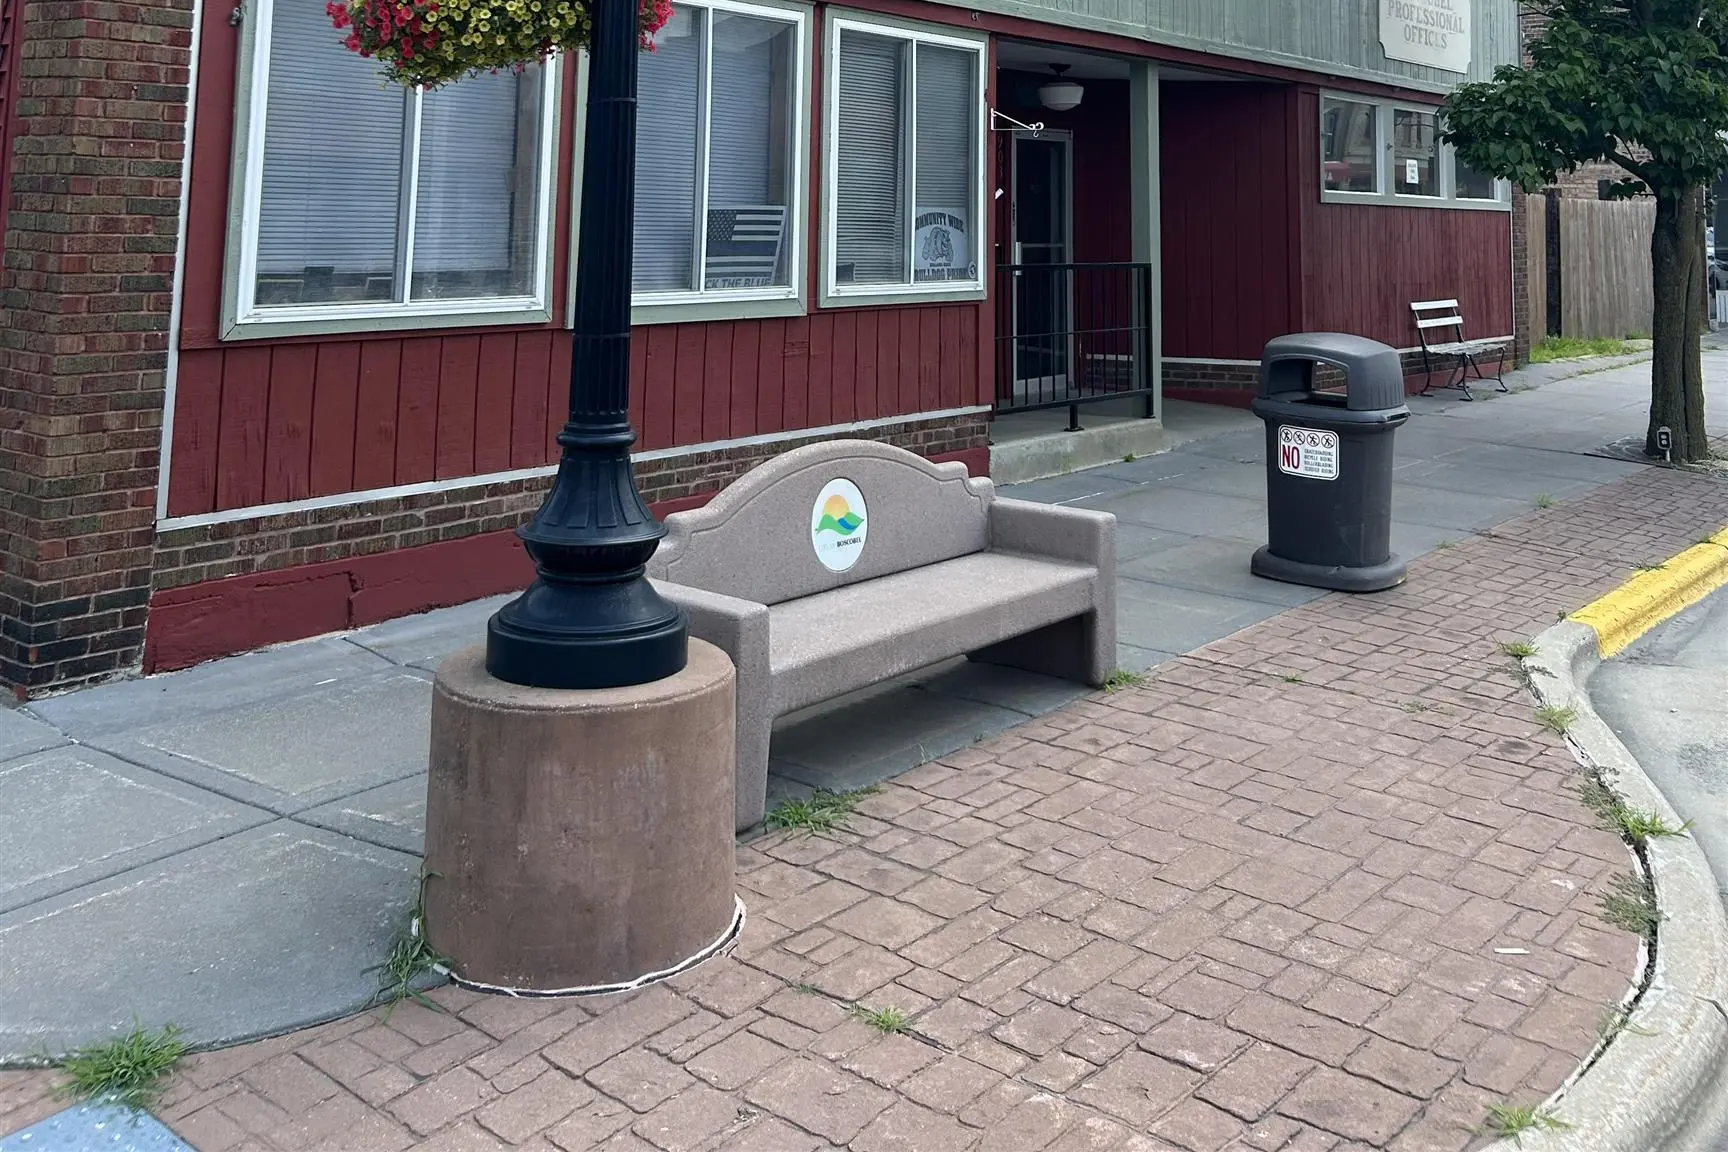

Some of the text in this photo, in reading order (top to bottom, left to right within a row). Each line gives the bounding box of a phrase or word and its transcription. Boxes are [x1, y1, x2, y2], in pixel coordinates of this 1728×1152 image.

[1403, 25, 1448, 49] OFFICES
[915, 212, 946, 232] OMMUNITY
[721, 278, 742, 288] THE
[1282, 444, 1299, 469] NO
